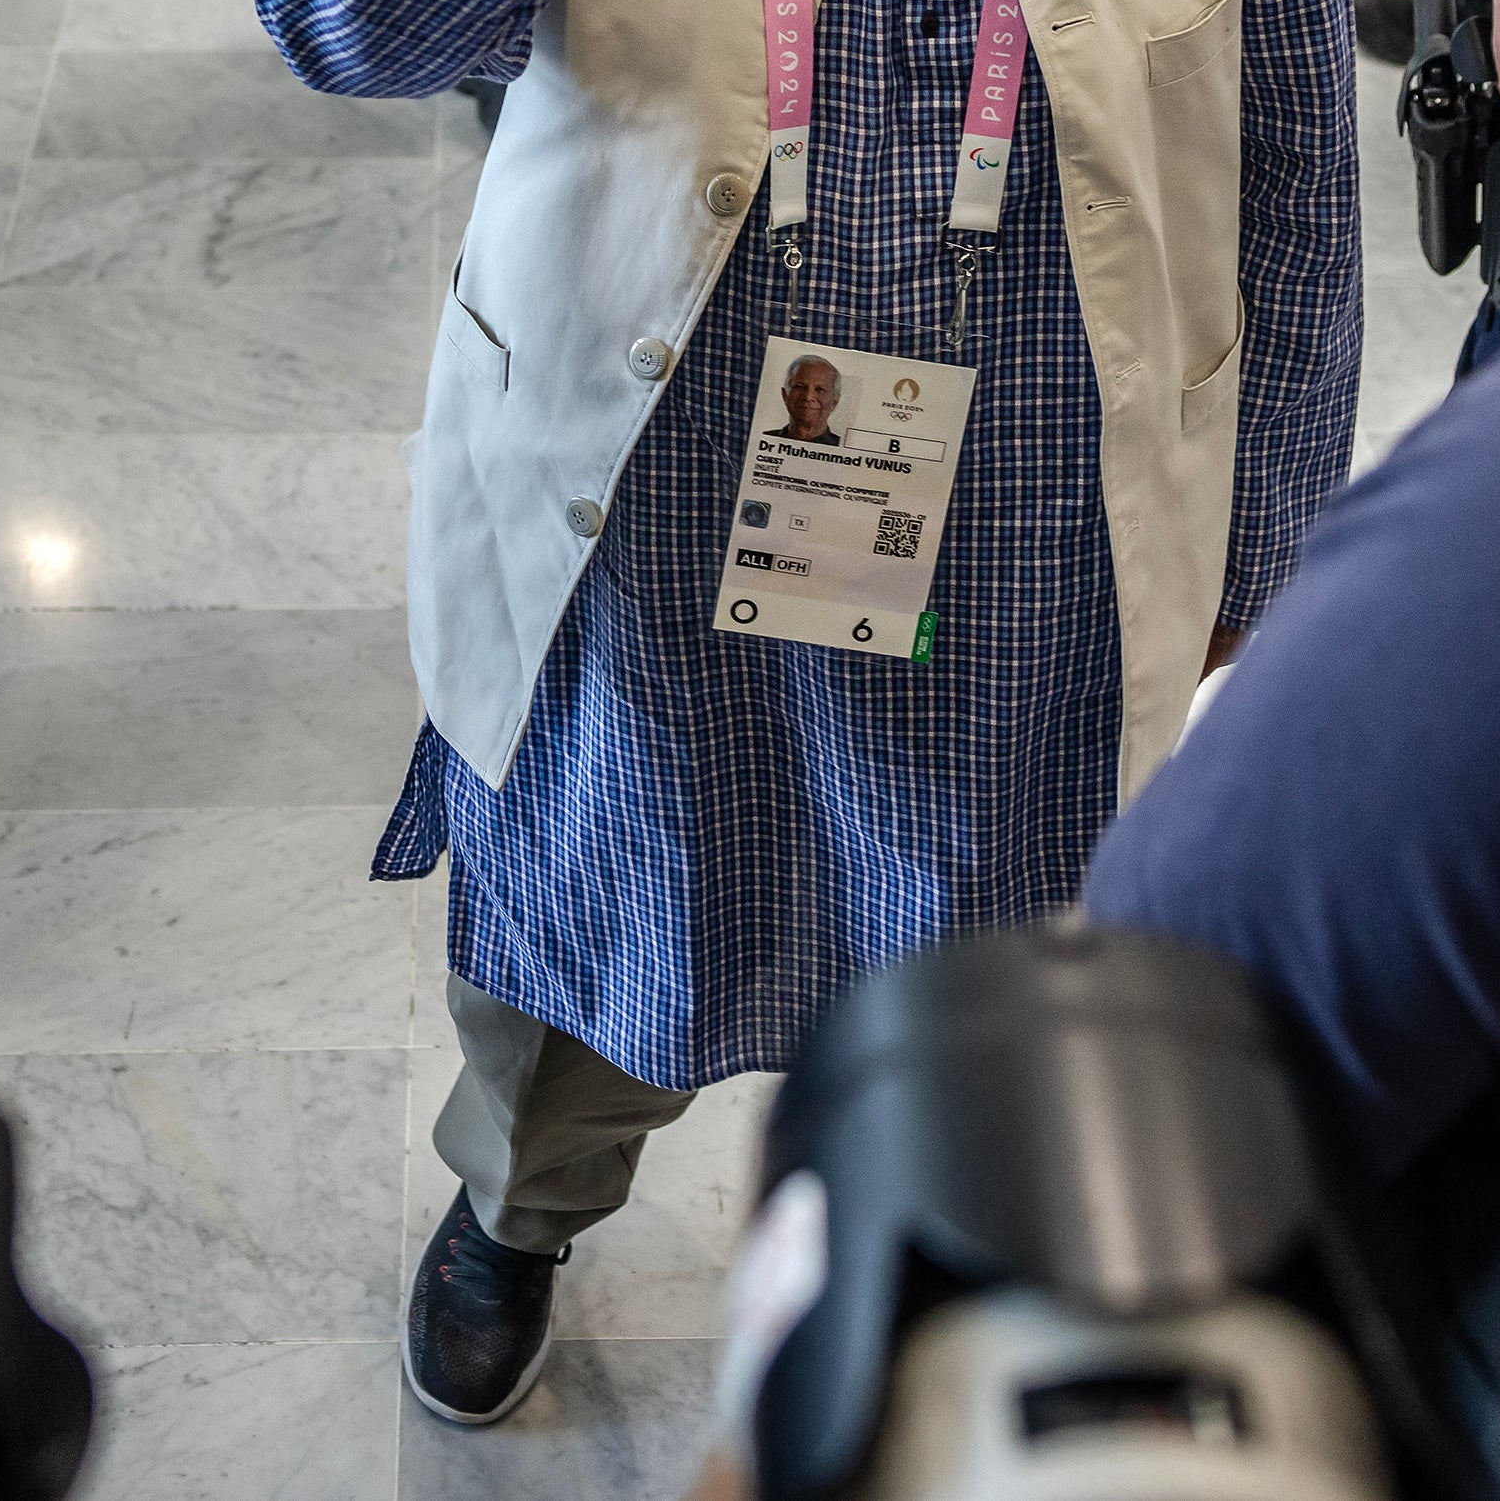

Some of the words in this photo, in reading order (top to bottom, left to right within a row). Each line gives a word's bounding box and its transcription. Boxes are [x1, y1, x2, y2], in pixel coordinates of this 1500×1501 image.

[778, 29, 800, 115] 2024
[758, 440, 775, 453] Dr
[777, 443, 862, 468] Muhammad
[864, 457, 912, 475] YUNUS
[888, 439, 901, 453] B
[739, 554, 769, 568] ALL
[776, 559, 807, 574] OFH
[852, 617, 873, 643] 6
